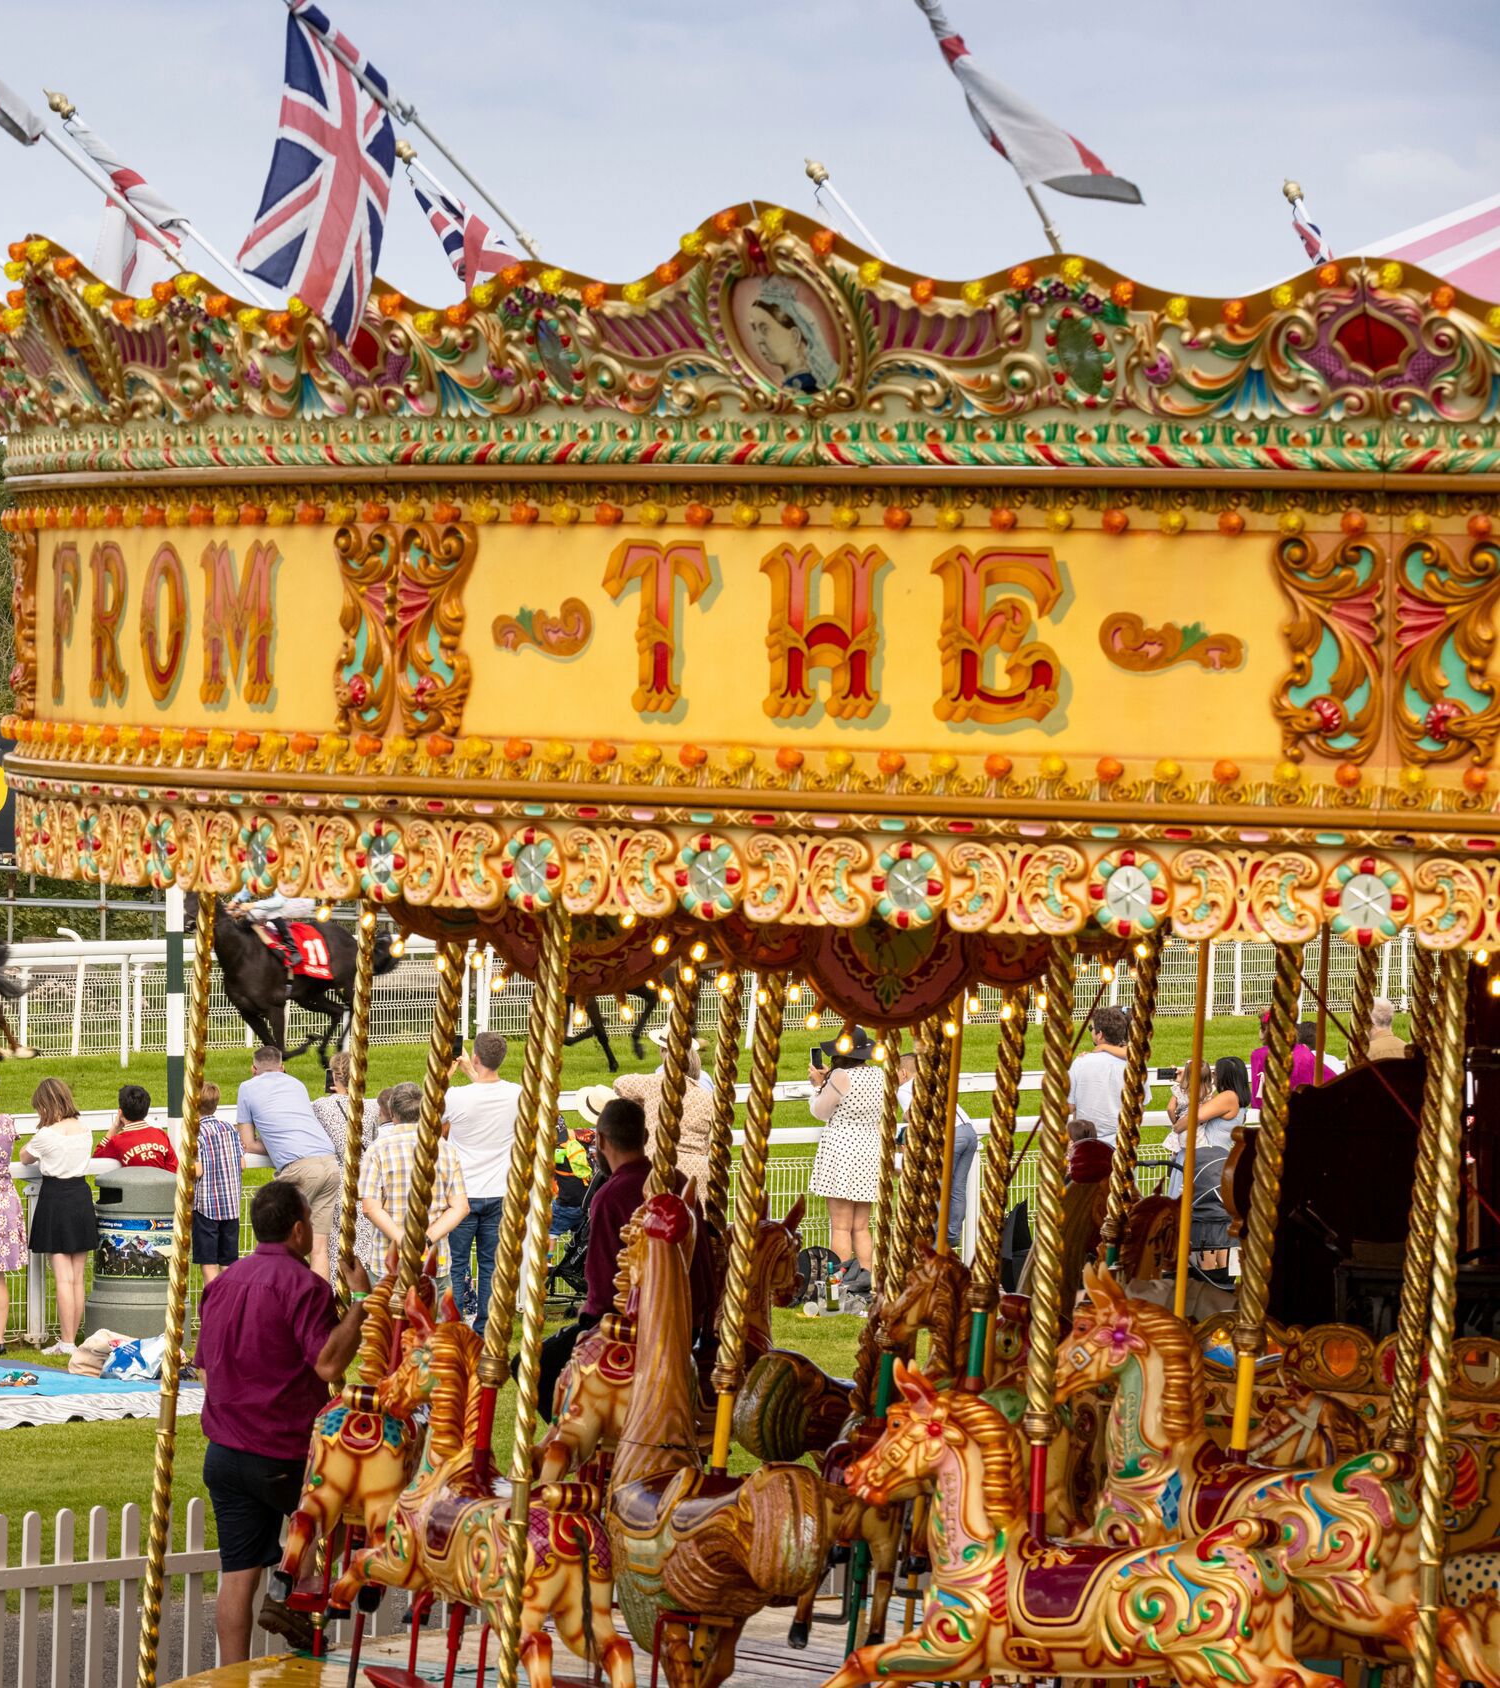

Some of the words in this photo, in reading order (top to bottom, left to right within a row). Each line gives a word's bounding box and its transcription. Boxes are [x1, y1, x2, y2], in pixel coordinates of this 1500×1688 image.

[51, 538, 282, 710] FROM
[601, 538, 1065, 730] THE
[303, 938, 328, 966] 11
[122, 1142, 169, 1166] LIVERPOOL
[141, 1150, 157, 1162] F.C.
